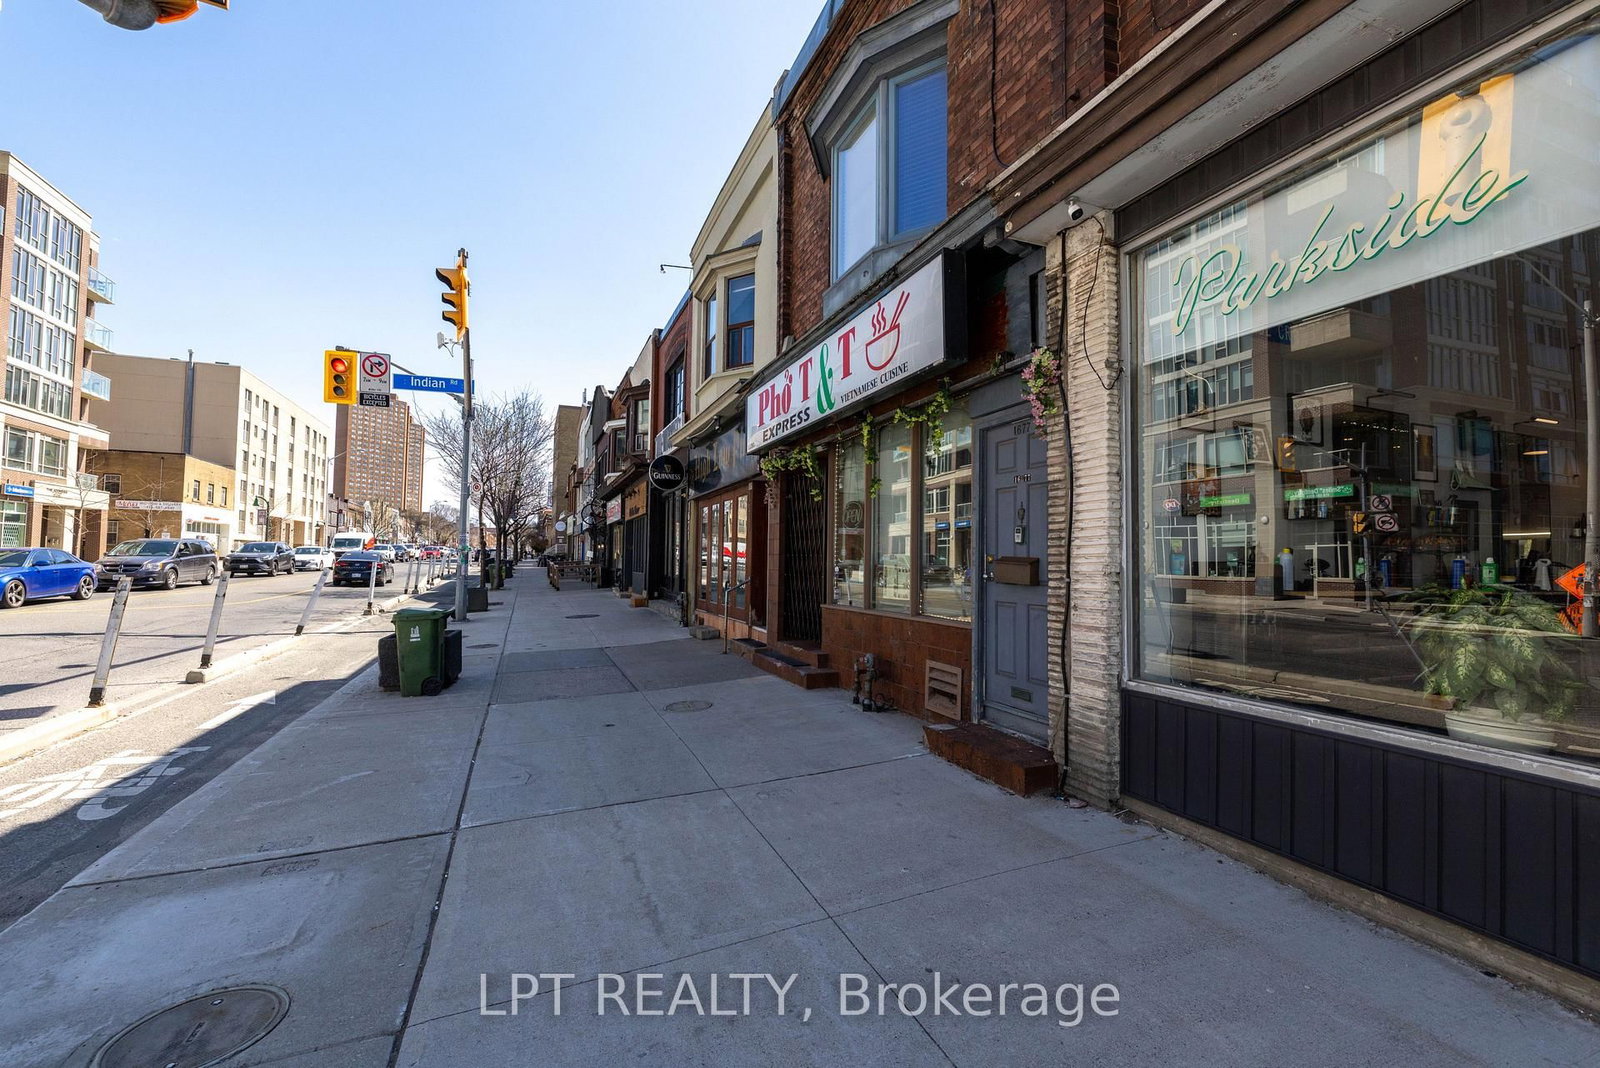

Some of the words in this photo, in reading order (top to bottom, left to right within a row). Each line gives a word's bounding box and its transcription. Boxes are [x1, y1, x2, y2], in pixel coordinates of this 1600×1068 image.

[1170, 131, 1529, 336] Parkside
[410, 376, 446, 389] Indian
[799, 357, 813, 403] T
[817, 342, 836, 415] &
[837, 326, 856, 381] T
[840, 377, 879, 404] VIETNAMESE
[880, 361, 909, 384] CUISINE
[762, 406, 811, 443] EXPRESS
[1013, 422, 1031, 436] 1677
[653, 471, 681, 481] GUINNESS
